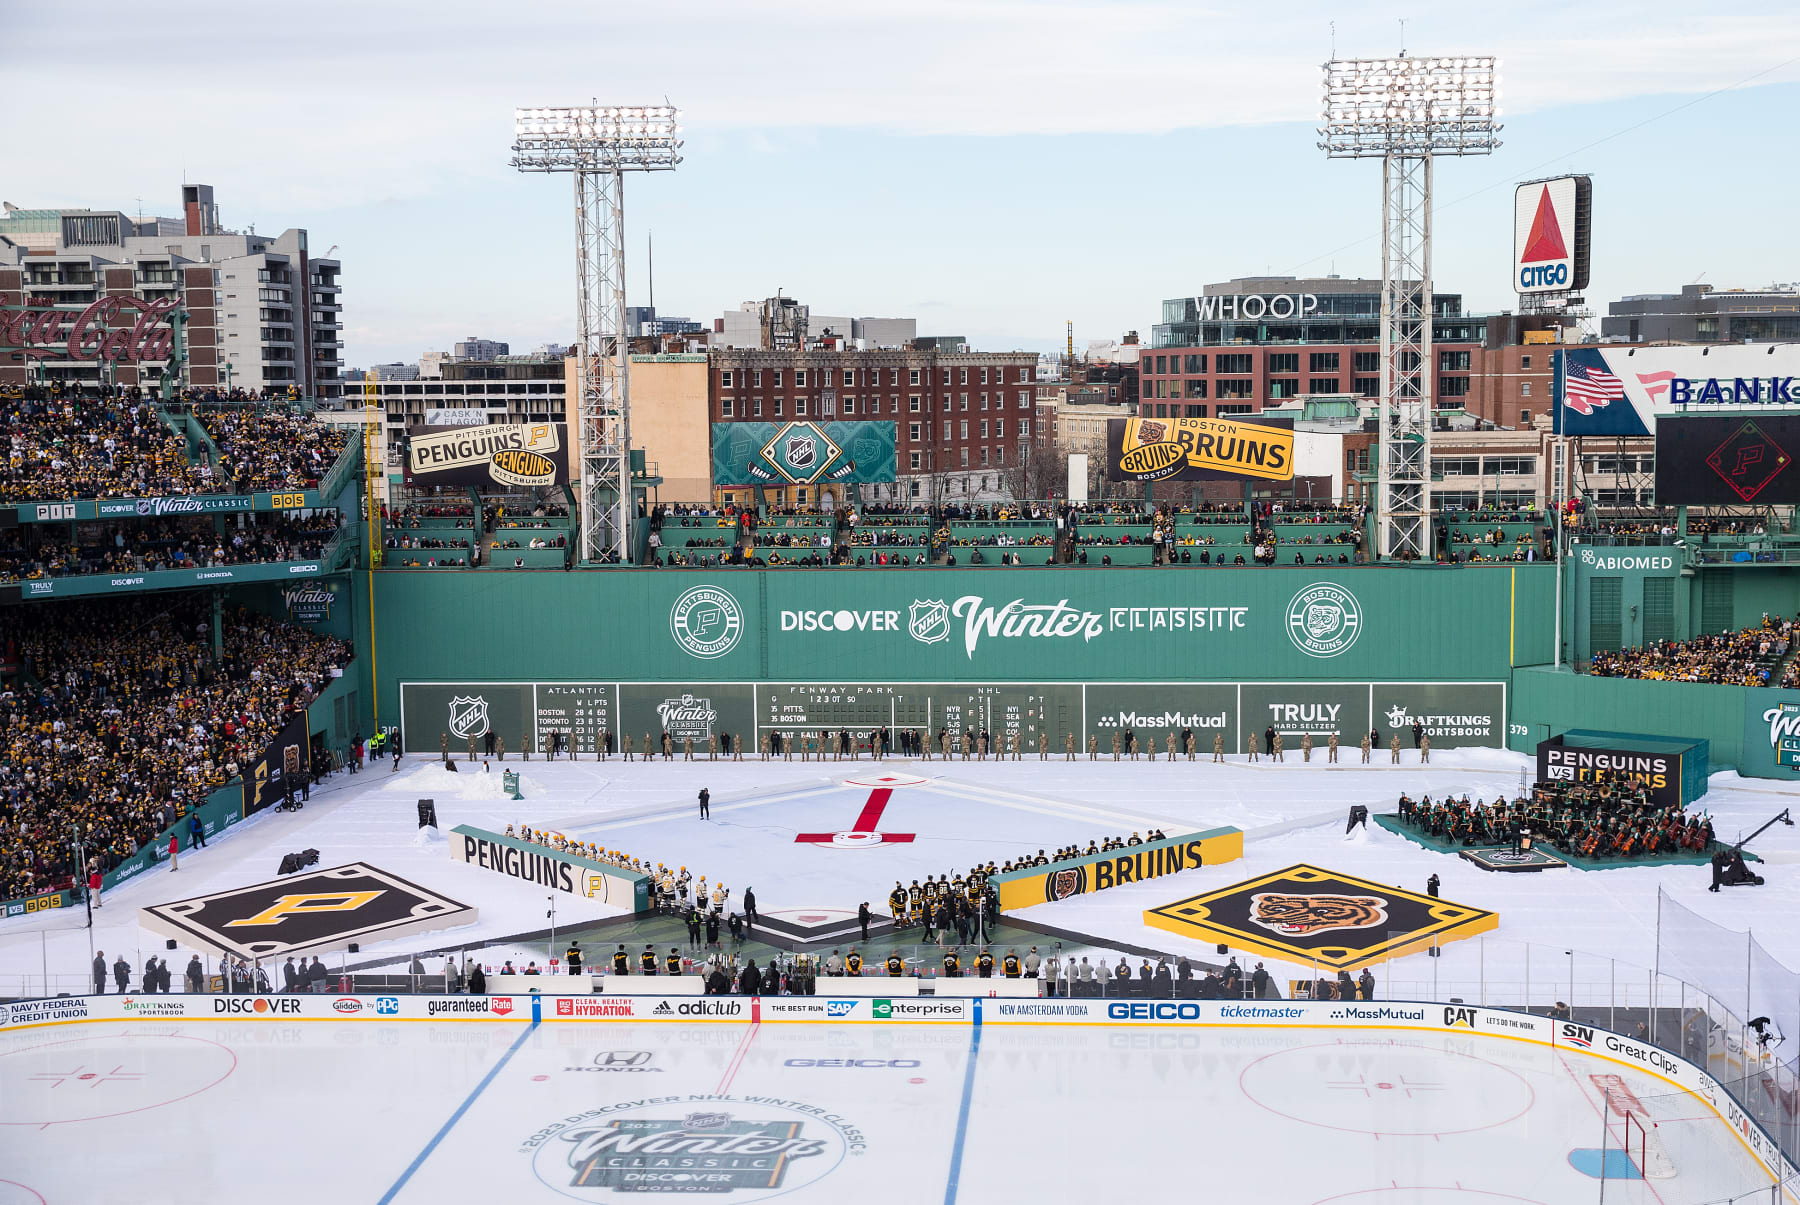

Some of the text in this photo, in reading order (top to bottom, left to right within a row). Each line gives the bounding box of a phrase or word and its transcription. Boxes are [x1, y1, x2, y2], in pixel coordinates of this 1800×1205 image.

[1520, 263, 1568, 288] CITGO
[1194, 294, 1318, 320] WHOOP
[456, 424, 519, 440] PITTSBURGH
[1180, 418, 1237, 434] BOSTON
[528, 425, 549, 446] P
[417, 432, 523, 465] PENGUINS
[792, 444, 810, 461] NHL
[1178, 430, 1286, 468] BRUINS
[494, 451, 552, 476] PENGUINS
[1124, 444, 1180, 472] BRUINS
[494, 468, 550, 484] PITTSBURGH
[1136, 466, 1174, 480] BOSTON
[101, 497, 248, 516] DISCOVER Winter CLASSIC
[273, 495, 304, 508] BOS
[38, 504, 74, 518] PIT
[290, 564, 318, 572] GEICO
[1596, 556, 1672, 570] ABIOMED
[112, 578, 144, 586] DISCOVER
[282, 588, 334, 610] Winter
[680, 592, 734, 614] PITTSBURGH
[1303, 590, 1344, 604] BOSTON
[694, 608, 720, 636] P
[781, 596, 1248, 661] DISCOVER NHL Winter CLASSIC
[684, 635, 731, 652] PENGUINS
[1304, 638, 1342, 650] BRUINS
[458, 708, 482, 732] NHL
[657, 704, 717, 730] Winter
[1120, 712, 1226, 728] MassMutual
[1268, 704, 1341, 722] TRULY
[1388, 714, 1492, 728] DRAFTKINGS
[1422, 728, 1490, 736] PORTSBOOK
[1510, 724, 1528, 736] 379
[1548, 750, 1668, 773] PENGUINS
[1552, 767, 1571, 778] VS
[464, 835, 573, 894] PENGUINS
[1096, 840, 1203, 891] BRUINS
[588, 876, 602, 898] P
[27, 897, 60, 912] BOS
[11, 999, 87, 1013] NAVY FEDERAL
[124, 1002, 184, 1011] DRAFTKINGS
[214, 998, 302, 1013] DISCOVER
[333, 1000, 362, 1010] Glidden
[377, 998, 398, 1013] PPG
[428, 998, 512, 1016] guaranteed Rate
[576, 1006, 634, 1016] HYDRATION.
[678, 1000, 740, 1015] adiclub
[828, 1003, 852, 1014] SAP
[878, 1004, 962, 1016] enterprise
[1000, 1005, 1088, 1016] NEW AMSTERDAM VODKA
[1108, 1003, 1200, 1019] GEICO
[1220, 1005, 1304, 1018] ticketmaster
[11, 1008, 88, 1023] CREDIT UNION
[1346, 1008, 1424, 1020] MassMutual
[1444, 1007, 1477, 1028] CAT
[1486, 1017, 1500, 1025] LET'S
[1509, 1020, 1518, 1028] THE
[1519, 1021, 1536, 1030] WORK.
[1562, 1024, 1594, 1042] SN
[1606, 1036, 1678, 1074] Great Clips
[784, 1059, 921, 1068] GEICO
[523, 1123, 566, 1148] 2023
[565, 1096, 680, 1123] DISCOVER
[744, 1096, 826, 1116] WINTER
[824, 1114, 866, 1150] CLASSIC
[1728, 1102, 1761, 1153] DISCOVER
[559, 1126, 827, 1168] Winter
[608, 1158, 767, 1168] CLASSIC
[624, 1173, 734, 1182] DISCOVER
